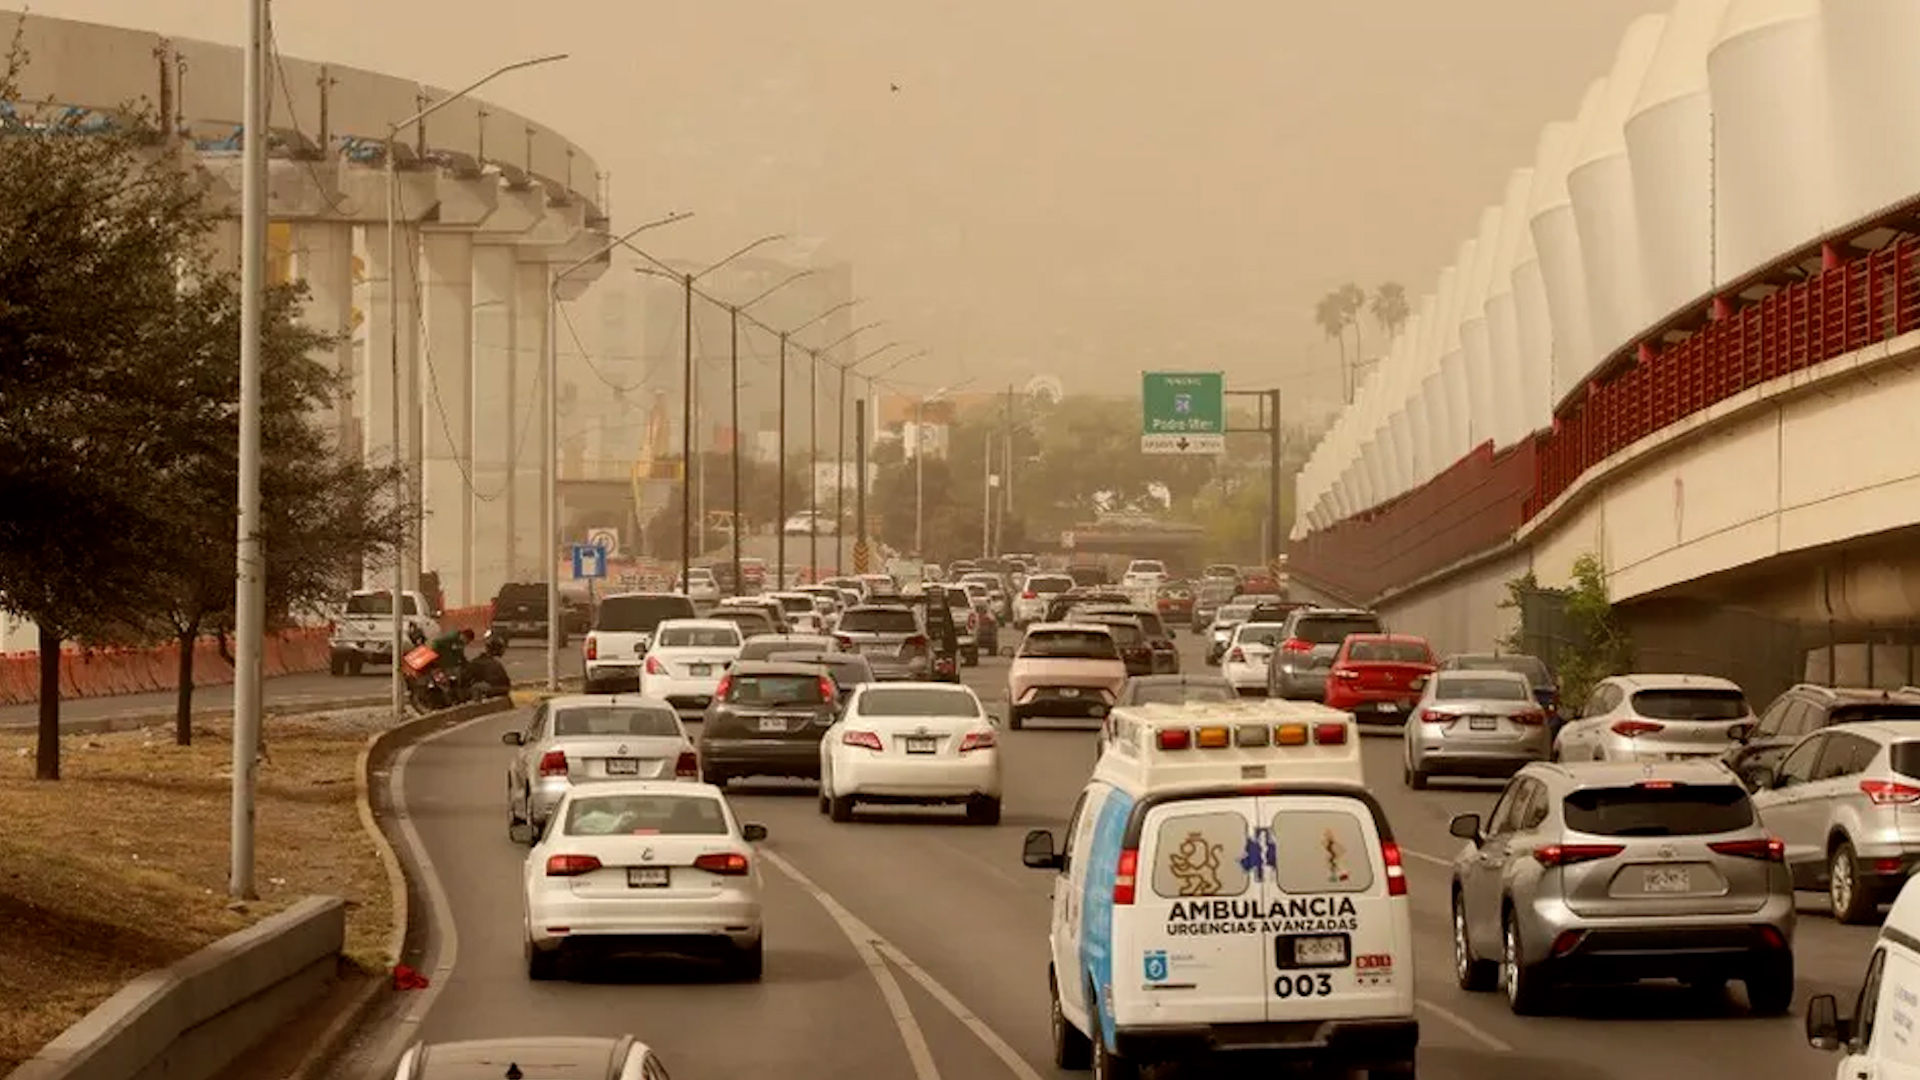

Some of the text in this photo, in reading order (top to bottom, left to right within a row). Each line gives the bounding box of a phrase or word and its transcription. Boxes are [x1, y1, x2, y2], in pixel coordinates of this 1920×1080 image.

[1168, 897, 1357, 921] AMBULANCIA
[1167, 918, 1358, 936] URGENCIAS AVANZADAS
[1274, 973, 1333, 998] 003
